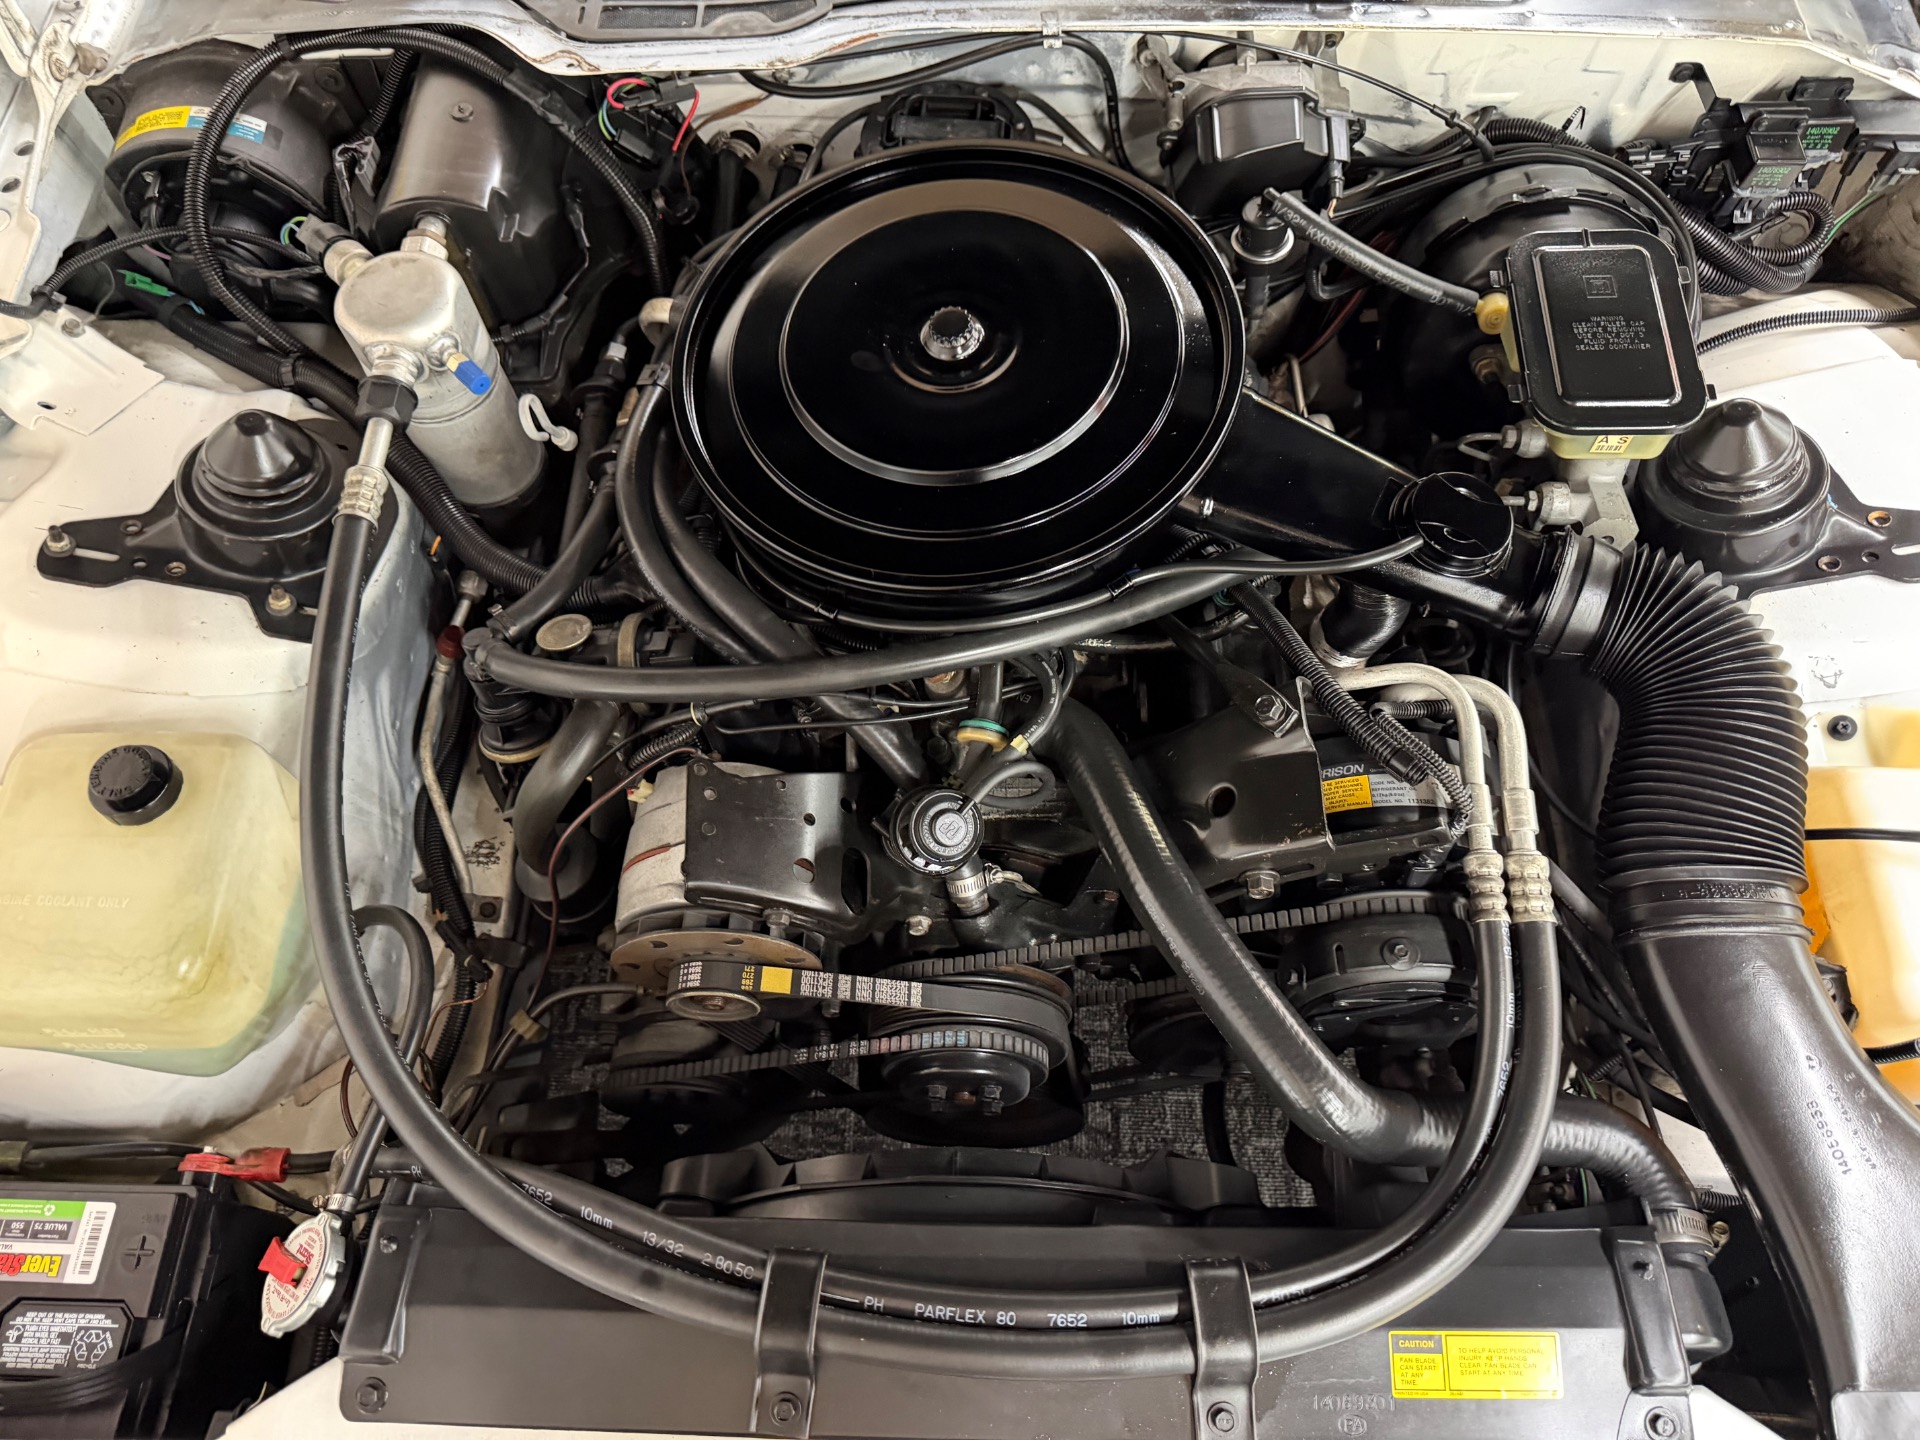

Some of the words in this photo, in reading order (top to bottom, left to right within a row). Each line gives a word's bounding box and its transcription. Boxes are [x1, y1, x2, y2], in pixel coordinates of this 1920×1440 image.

[1598, 435, 1609, 444] A
[1617, 436, 1629, 444] S
[1321, 764, 1365, 779] RISON
[36, 895, 94, 908] COOLANT
[97, 895, 130, 909] ONLY
[801, 976, 833, 987] 5PK1100
[800, 984, 833, 994] 5PK1100
[1496, 1060, 1511, 1099] 7652
[411, 1165, 422, 1178] PH
[11, 1221, 25, 1229] 550
[33, 1222, 43, 1230] 75
[44, 1222, 68, 1231] VALUE
[580, 1205, 614, 1230] 10mm
[642, 1230, 685, 1258] 13/32
[0, 1243, 13, 1251] VAL
[864, 1296, 885, 1312] PH
[914, 1303, 986, 1325] PARFLEX
[995, 1312, 1017, 1326] 80
[1047, 1312, 1088, 1327] 7652
[1121, 1310, 1161, 1325] 10mm
[1398, 1340, 1435, 1348] CAUTION
